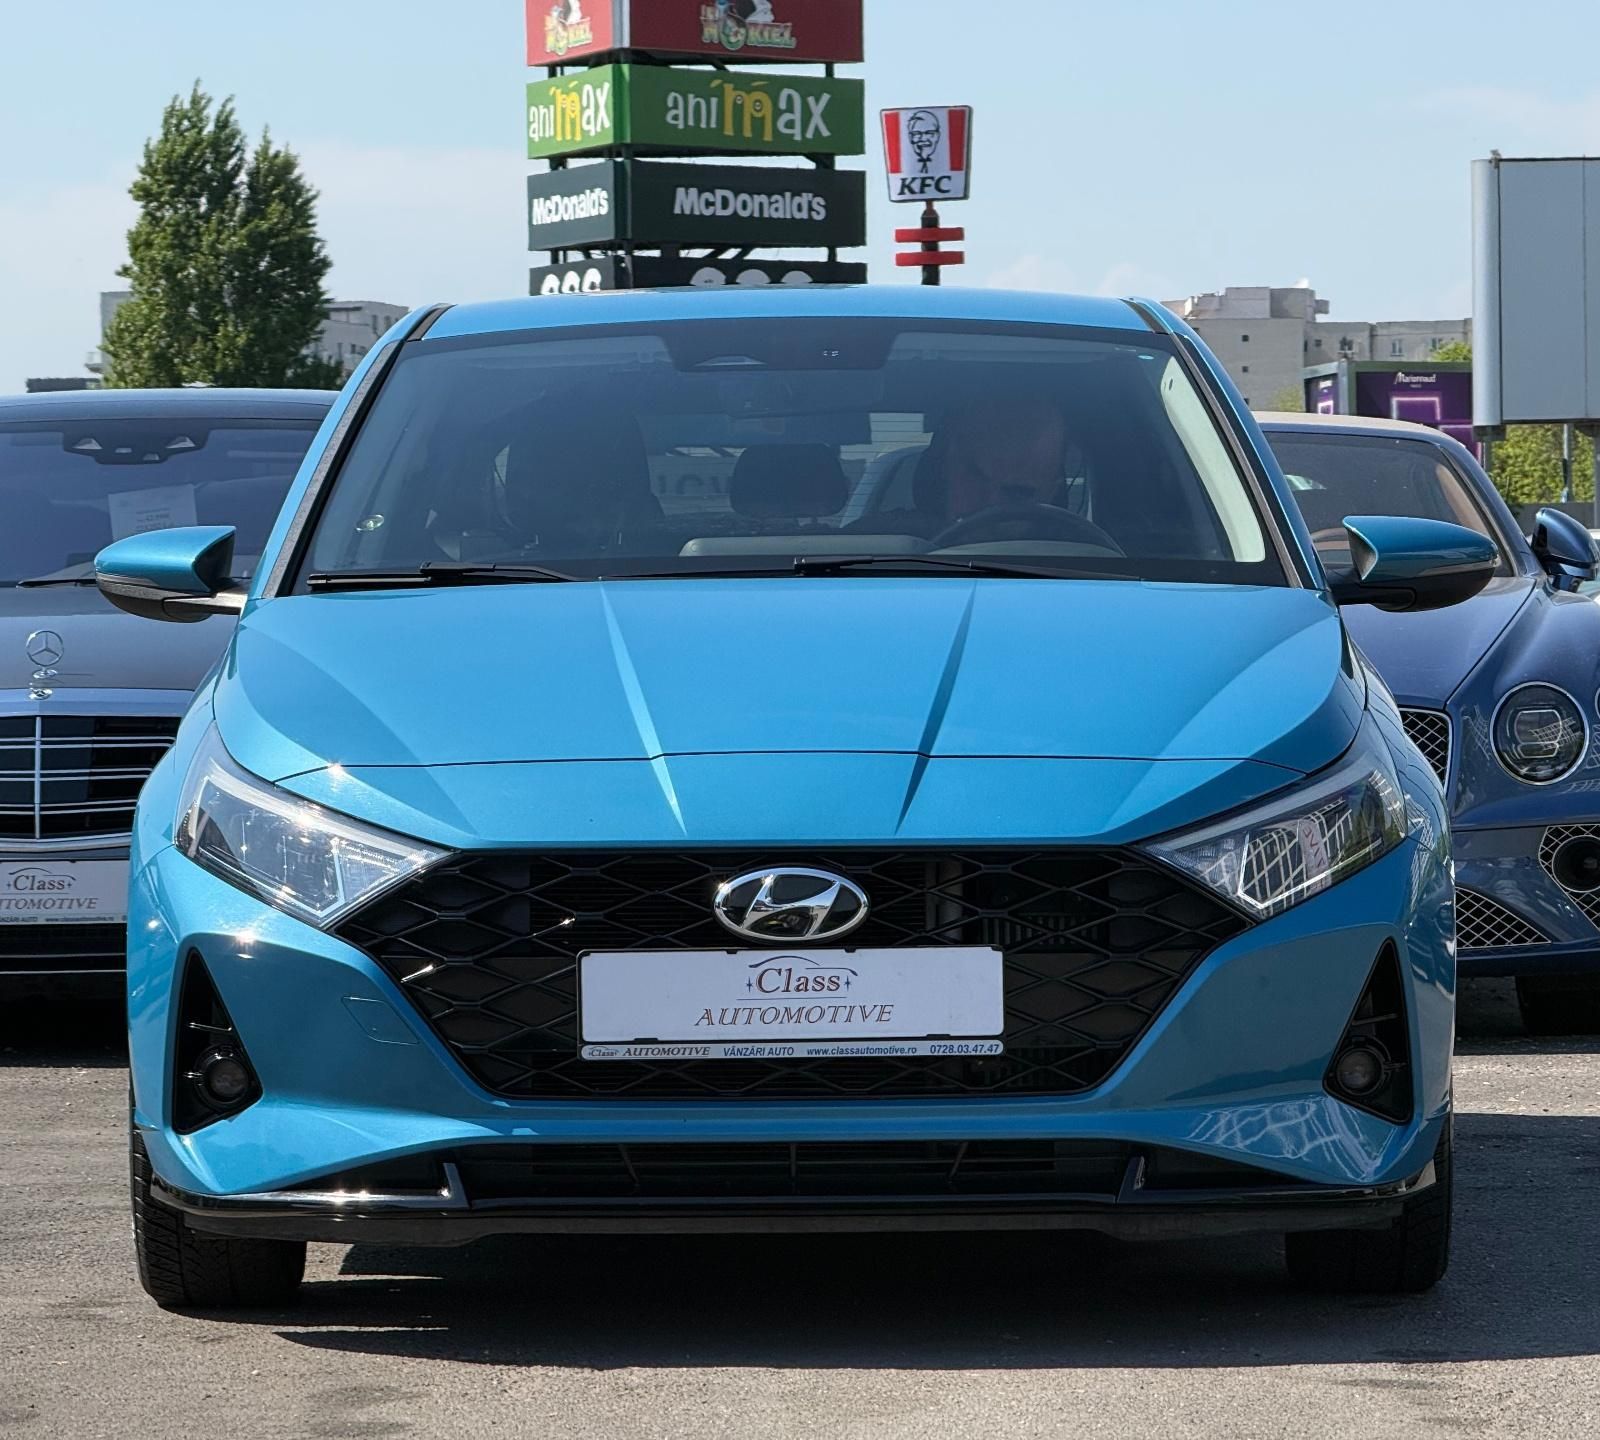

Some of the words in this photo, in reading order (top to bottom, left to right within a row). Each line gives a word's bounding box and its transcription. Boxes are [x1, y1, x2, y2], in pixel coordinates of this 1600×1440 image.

[529, 81, 611, 142] animax
[665, 80, 832, 142] animax
[897, 175, 952, 196] KFC
[532, 187, 609, 225] McDonald's
[673, 186, 827, 221] McDonald's
[13, 874, 66, 891] Class
[0, 897, 99, 910] TOMOTIVE
[755, 967, 841, 994] Class
[694, 1004, 895, 1027] AUTOMOTIVE
[622, 1046, 711, 1057] AUTOMOTIVE
[767, 1046, 795, 1057] AUTO
[806, 1045, 918, 1056] www.classautomotive.ro
[929, 1043, 1000, 1055] 0728.03.47.47
